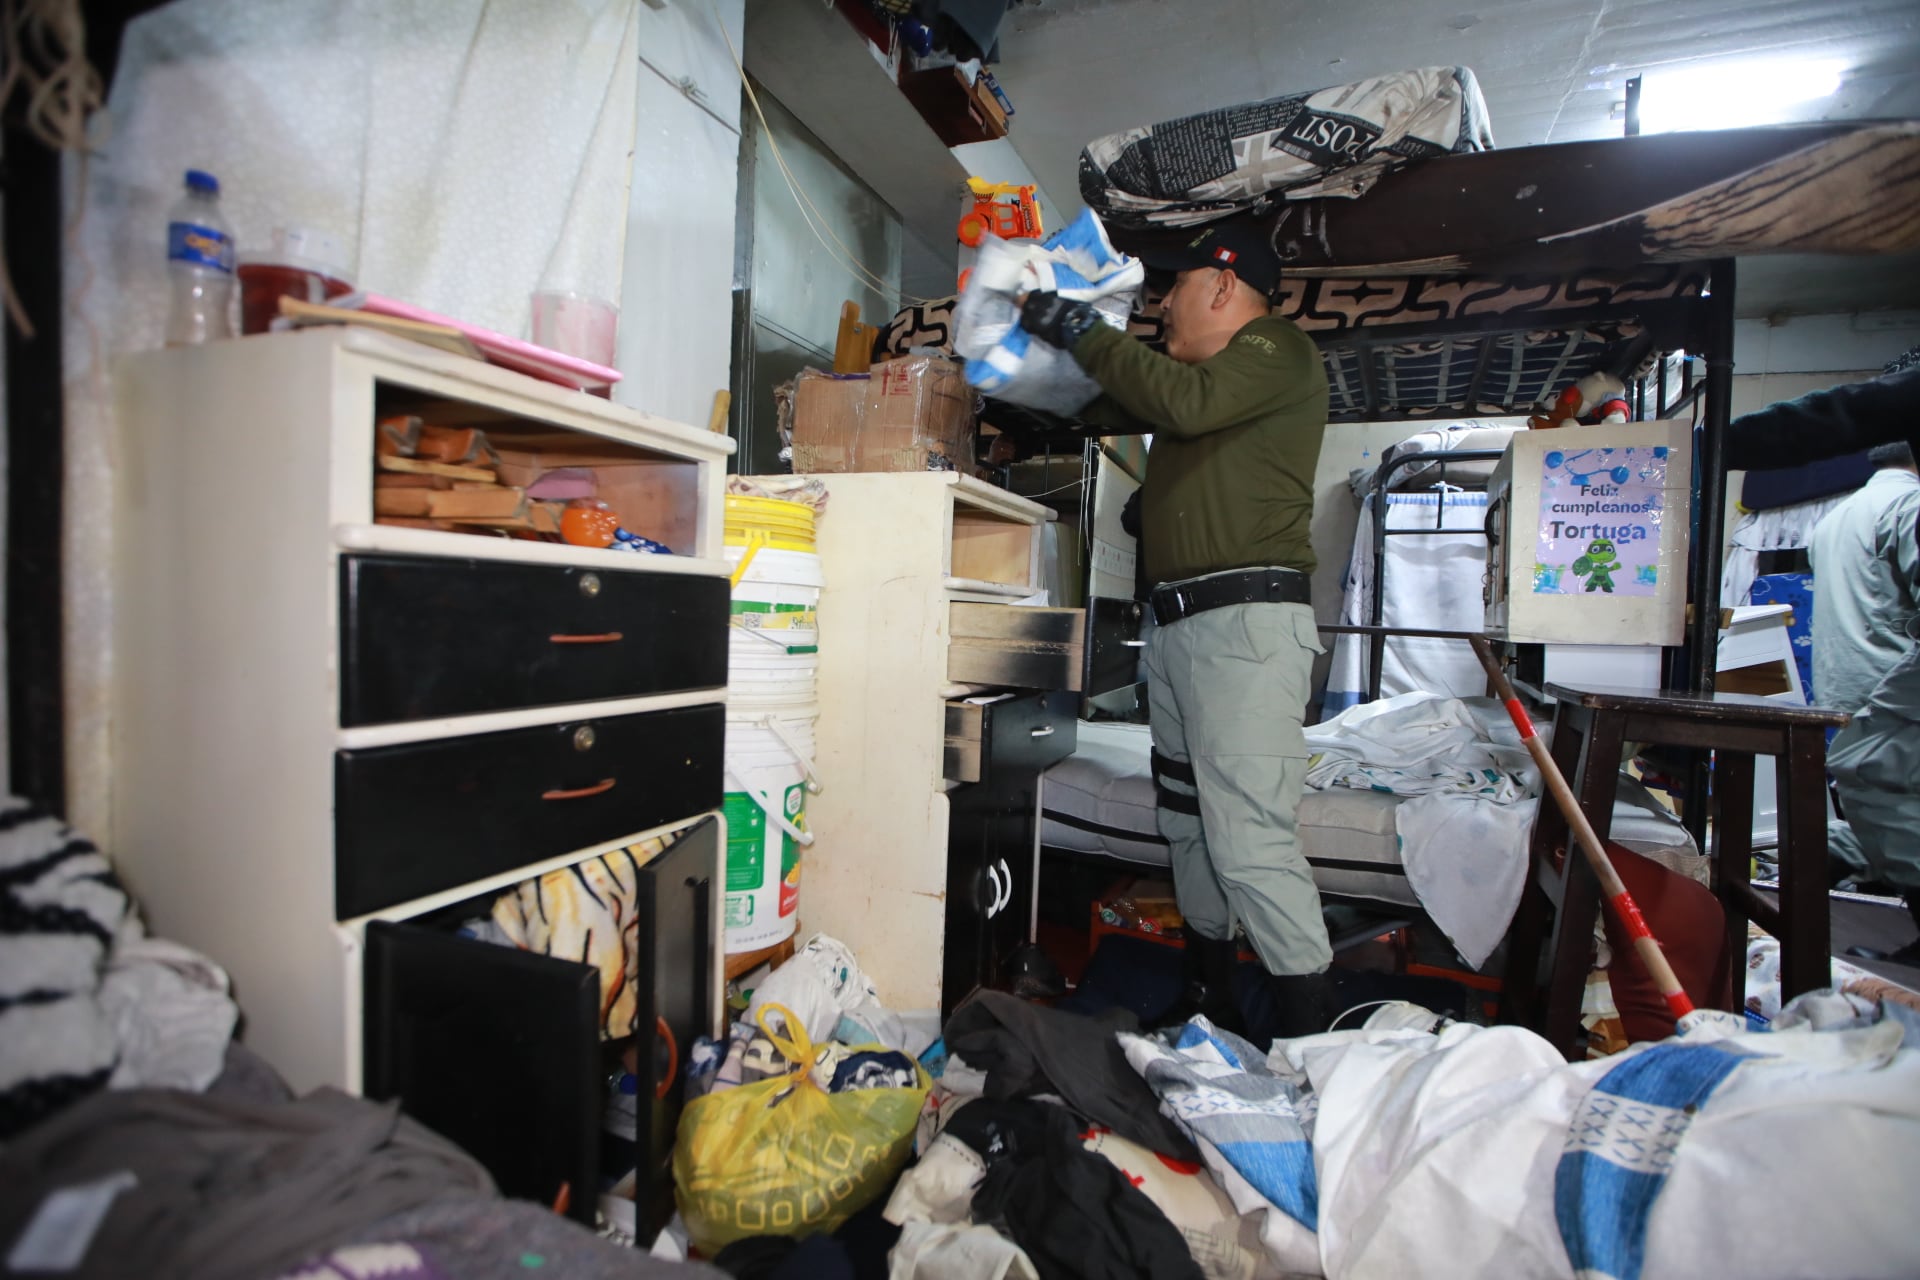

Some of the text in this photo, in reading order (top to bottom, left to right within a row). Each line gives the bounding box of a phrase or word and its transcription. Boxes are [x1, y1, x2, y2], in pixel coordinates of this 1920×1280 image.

[1292, 115, 1375, 155] POST
[1580, 484, 1619, 496] Feliz
[1552, 501, 1650, 516] cumpleanos
[1550, 521, 1646, 544] Tortuga
